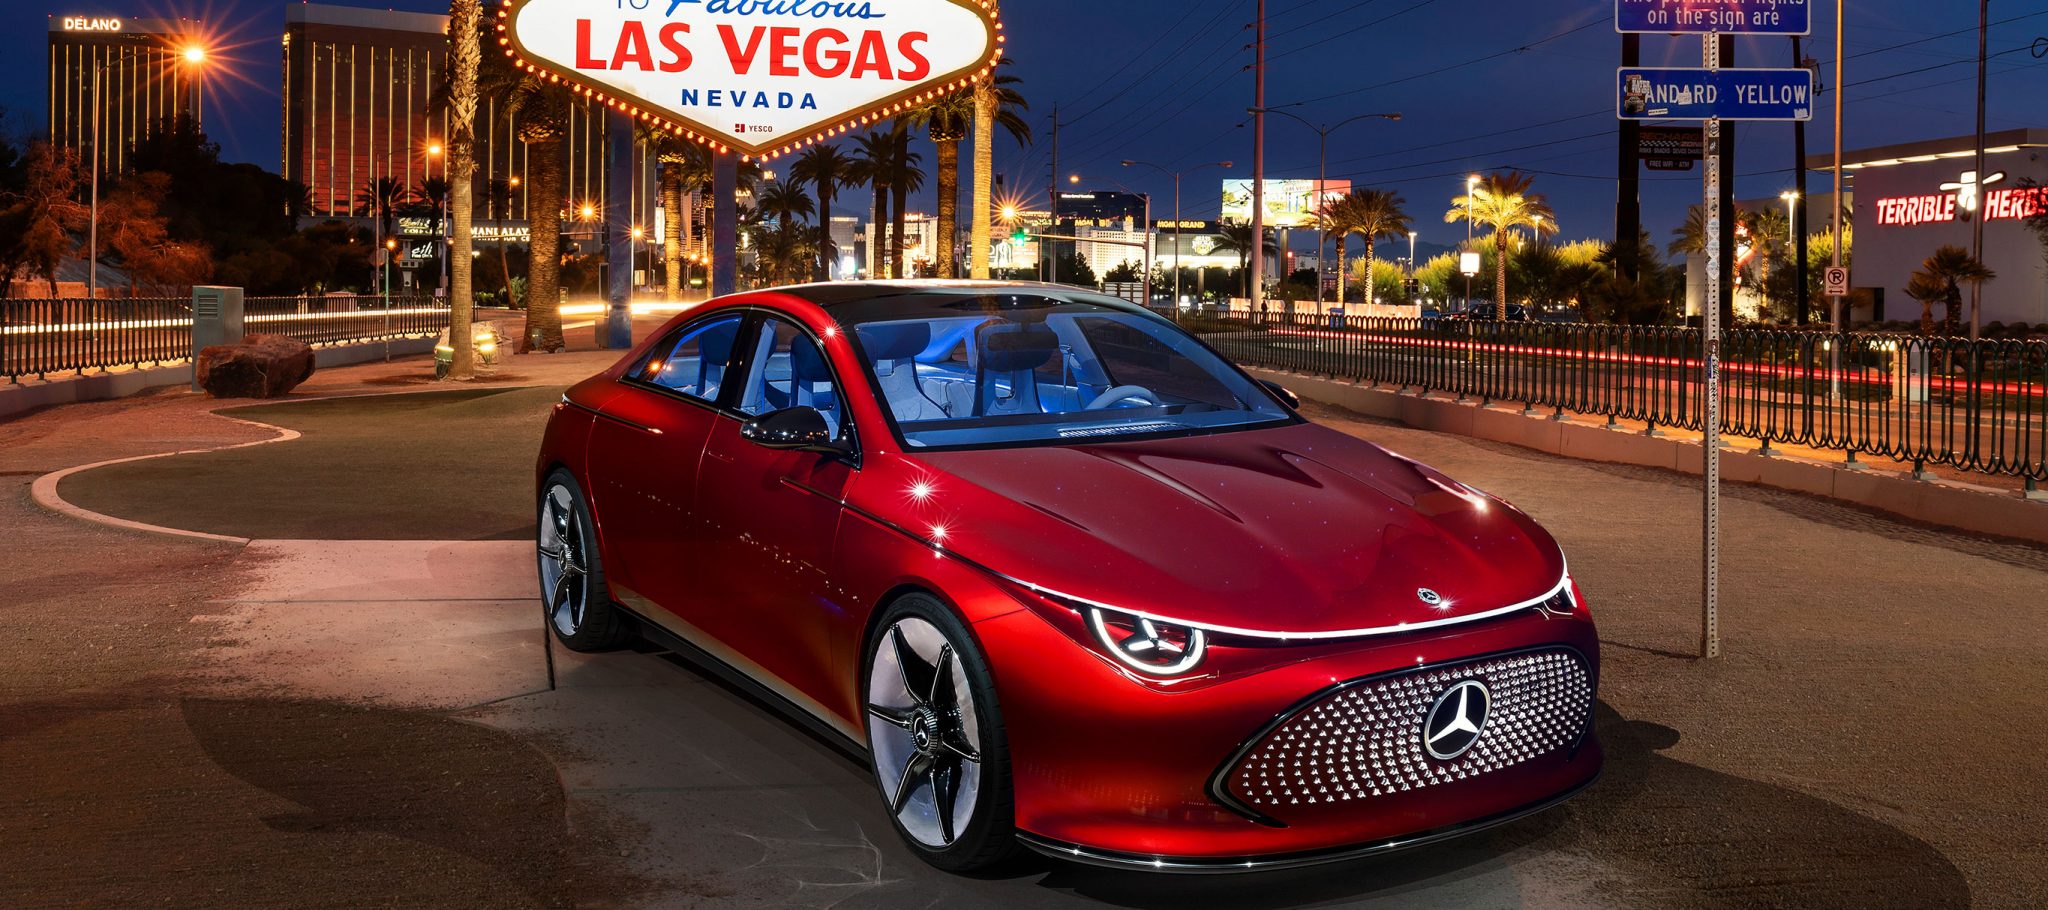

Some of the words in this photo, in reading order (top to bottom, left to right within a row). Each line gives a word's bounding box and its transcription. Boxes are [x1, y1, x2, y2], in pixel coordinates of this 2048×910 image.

[64, 18, 121, 31] DELANO
[1647, 10, 1667, 24] on
[1675, 7, 1703, 24] the
[1709, 7, 1745, 31] sign
[1753, 11, 1780, 25] are
[576, 19, 693, 73] LAS
[716, 24, 931, 81] VEGAS
[681, 88, 818, 110] NEVADA
[1624, 84, 1718, 104] ANDRD
[1735, 84, 1807, 104] YELLOW
[748, 125, 773, 133] YESCO
[1876, 193, 1957, 226] TERRIBLE
[1178, 220, 1206, 229] GRAND
